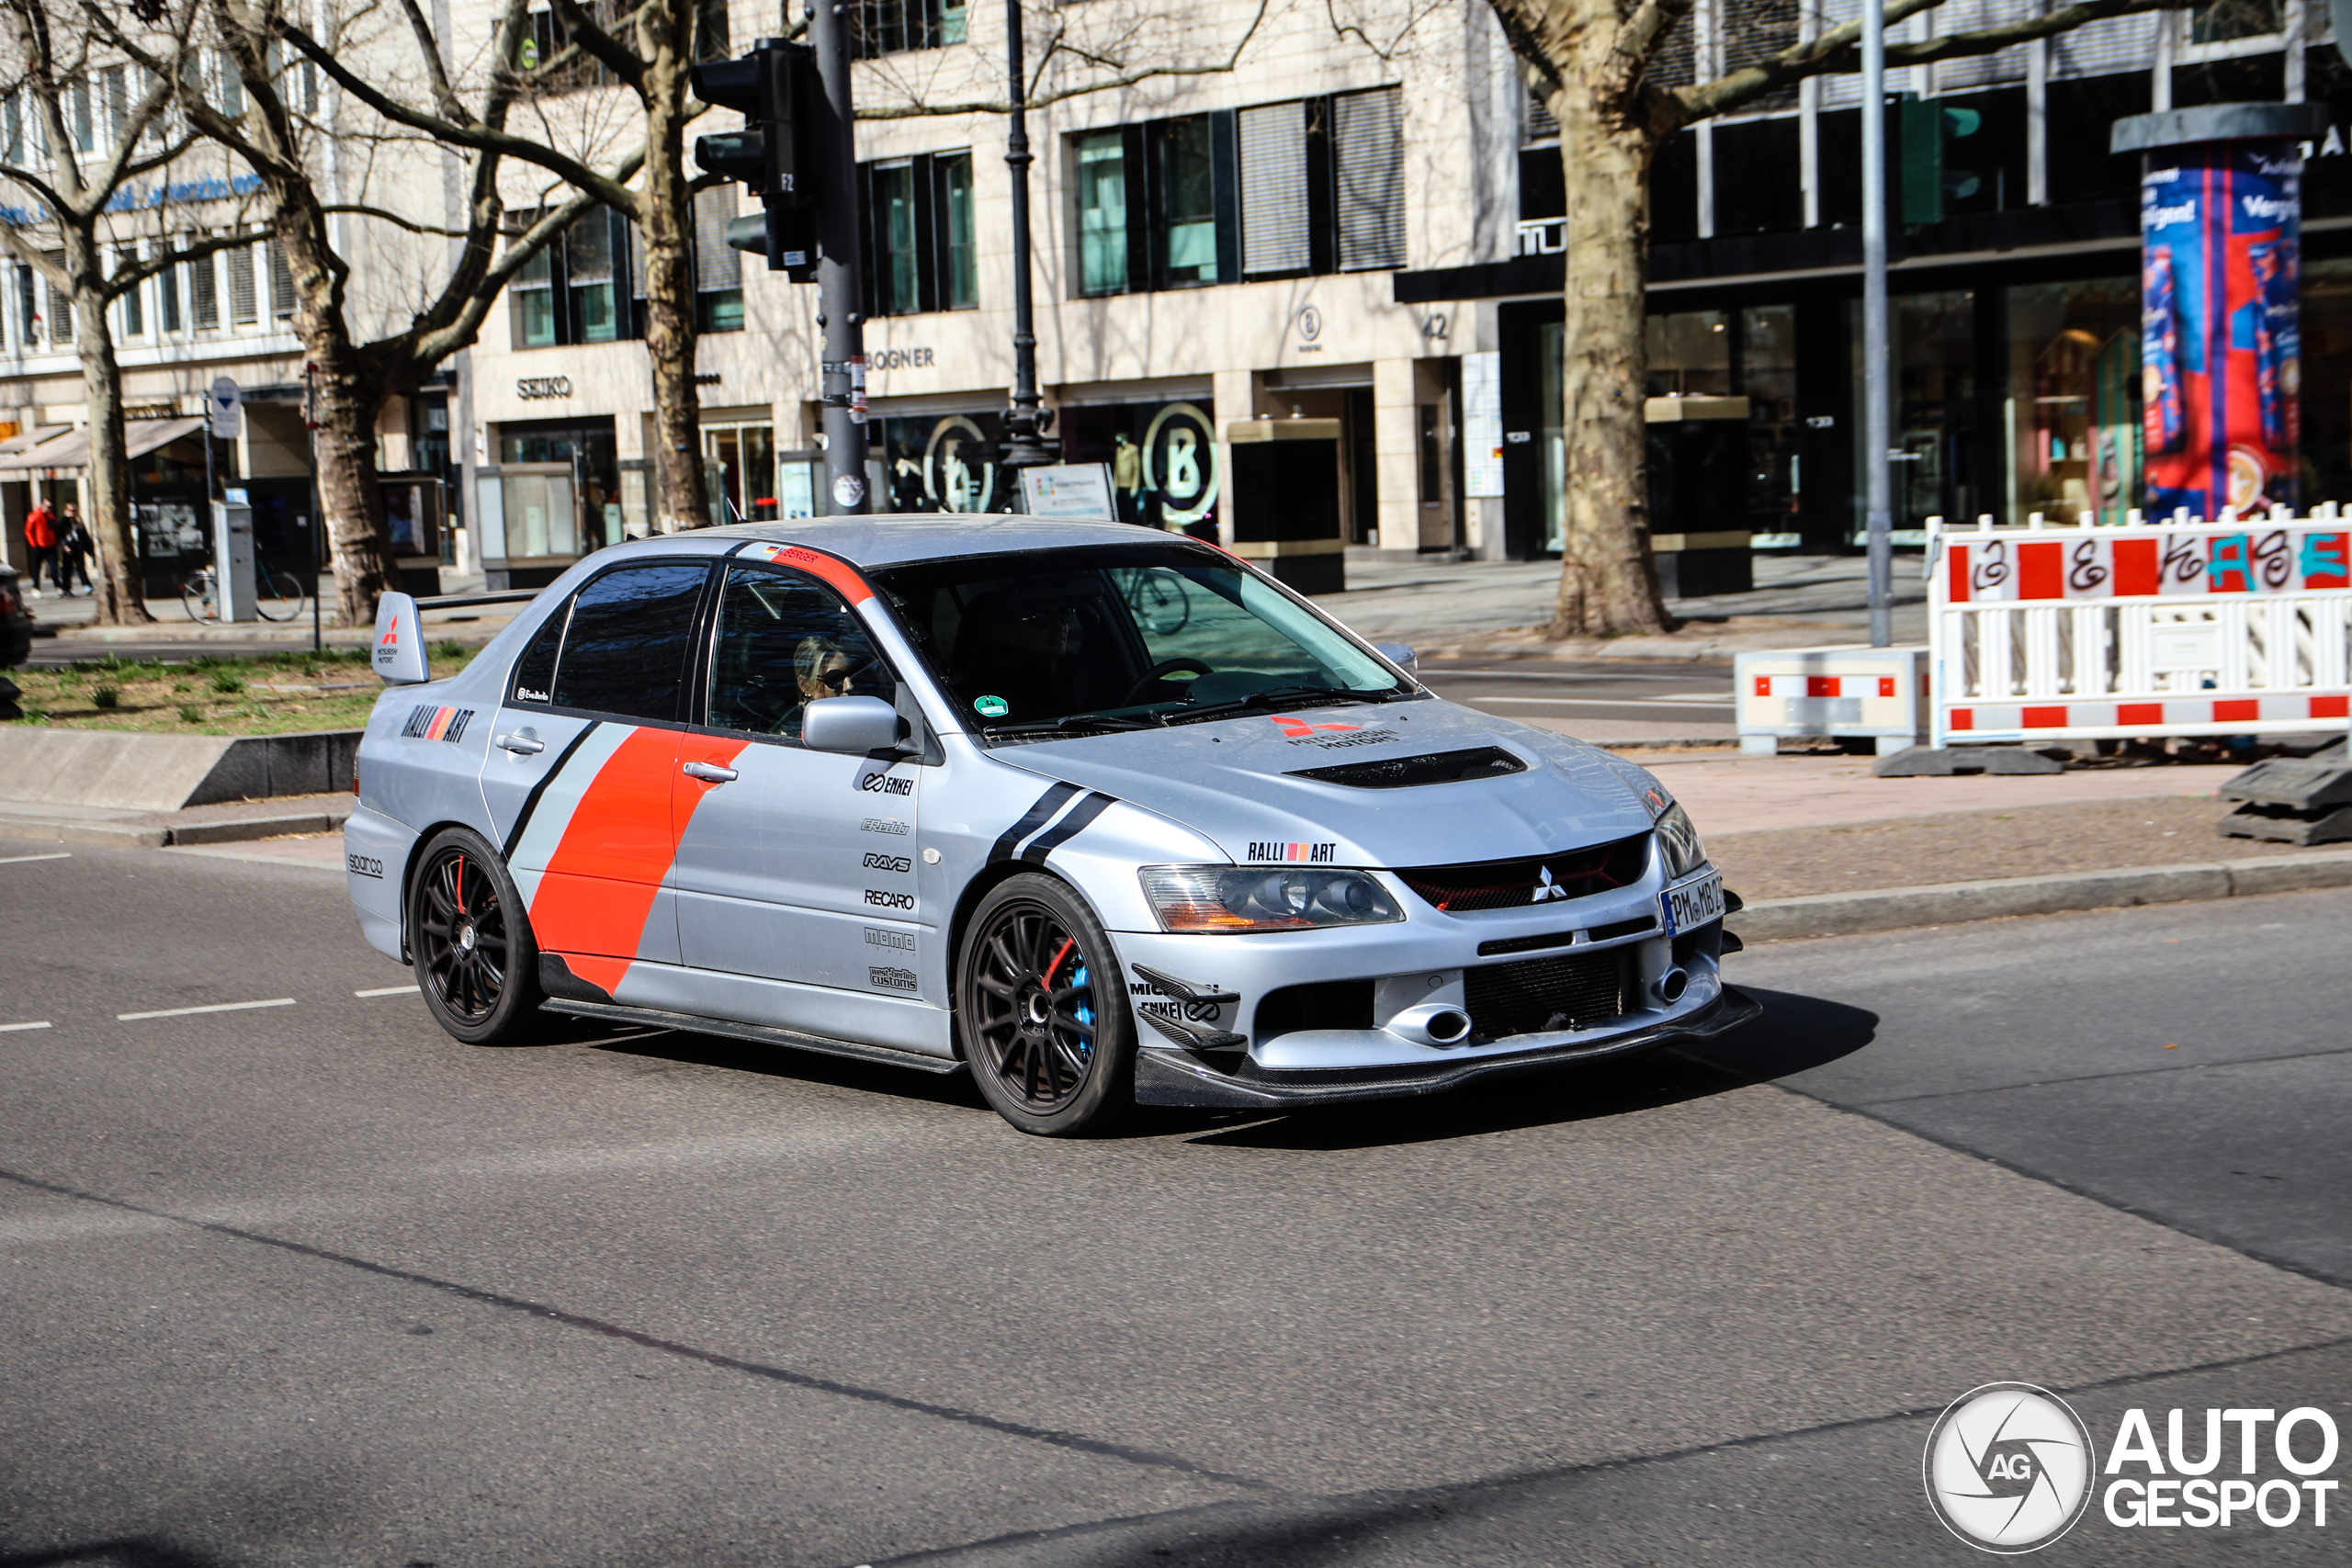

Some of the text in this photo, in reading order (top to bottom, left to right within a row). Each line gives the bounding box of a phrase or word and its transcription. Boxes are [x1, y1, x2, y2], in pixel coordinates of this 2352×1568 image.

[1421, 312, 1448, 341] 42
[864, 347, 935, 371] BOGNER
[517, 376, 572, 400] SEIKO
[443, 708, 476, 743] ART
[1286, 728, 1398, 747] MITSUBISHI
[1317, 736, 1400, 750] MOTORS
[884, 776, 914, 796] ENKEI
[863, 852, 911, 873] RAYS
[1248, 842, 1337, 862] RALLI ART
[349, 853, 383, 875] sparco
[865, 889, 914, 910] RECARO
[1671, 889, 1693, 928] PM
[1697, 882, 1714, 918] MB
[872, 976, 916, 989] customs
